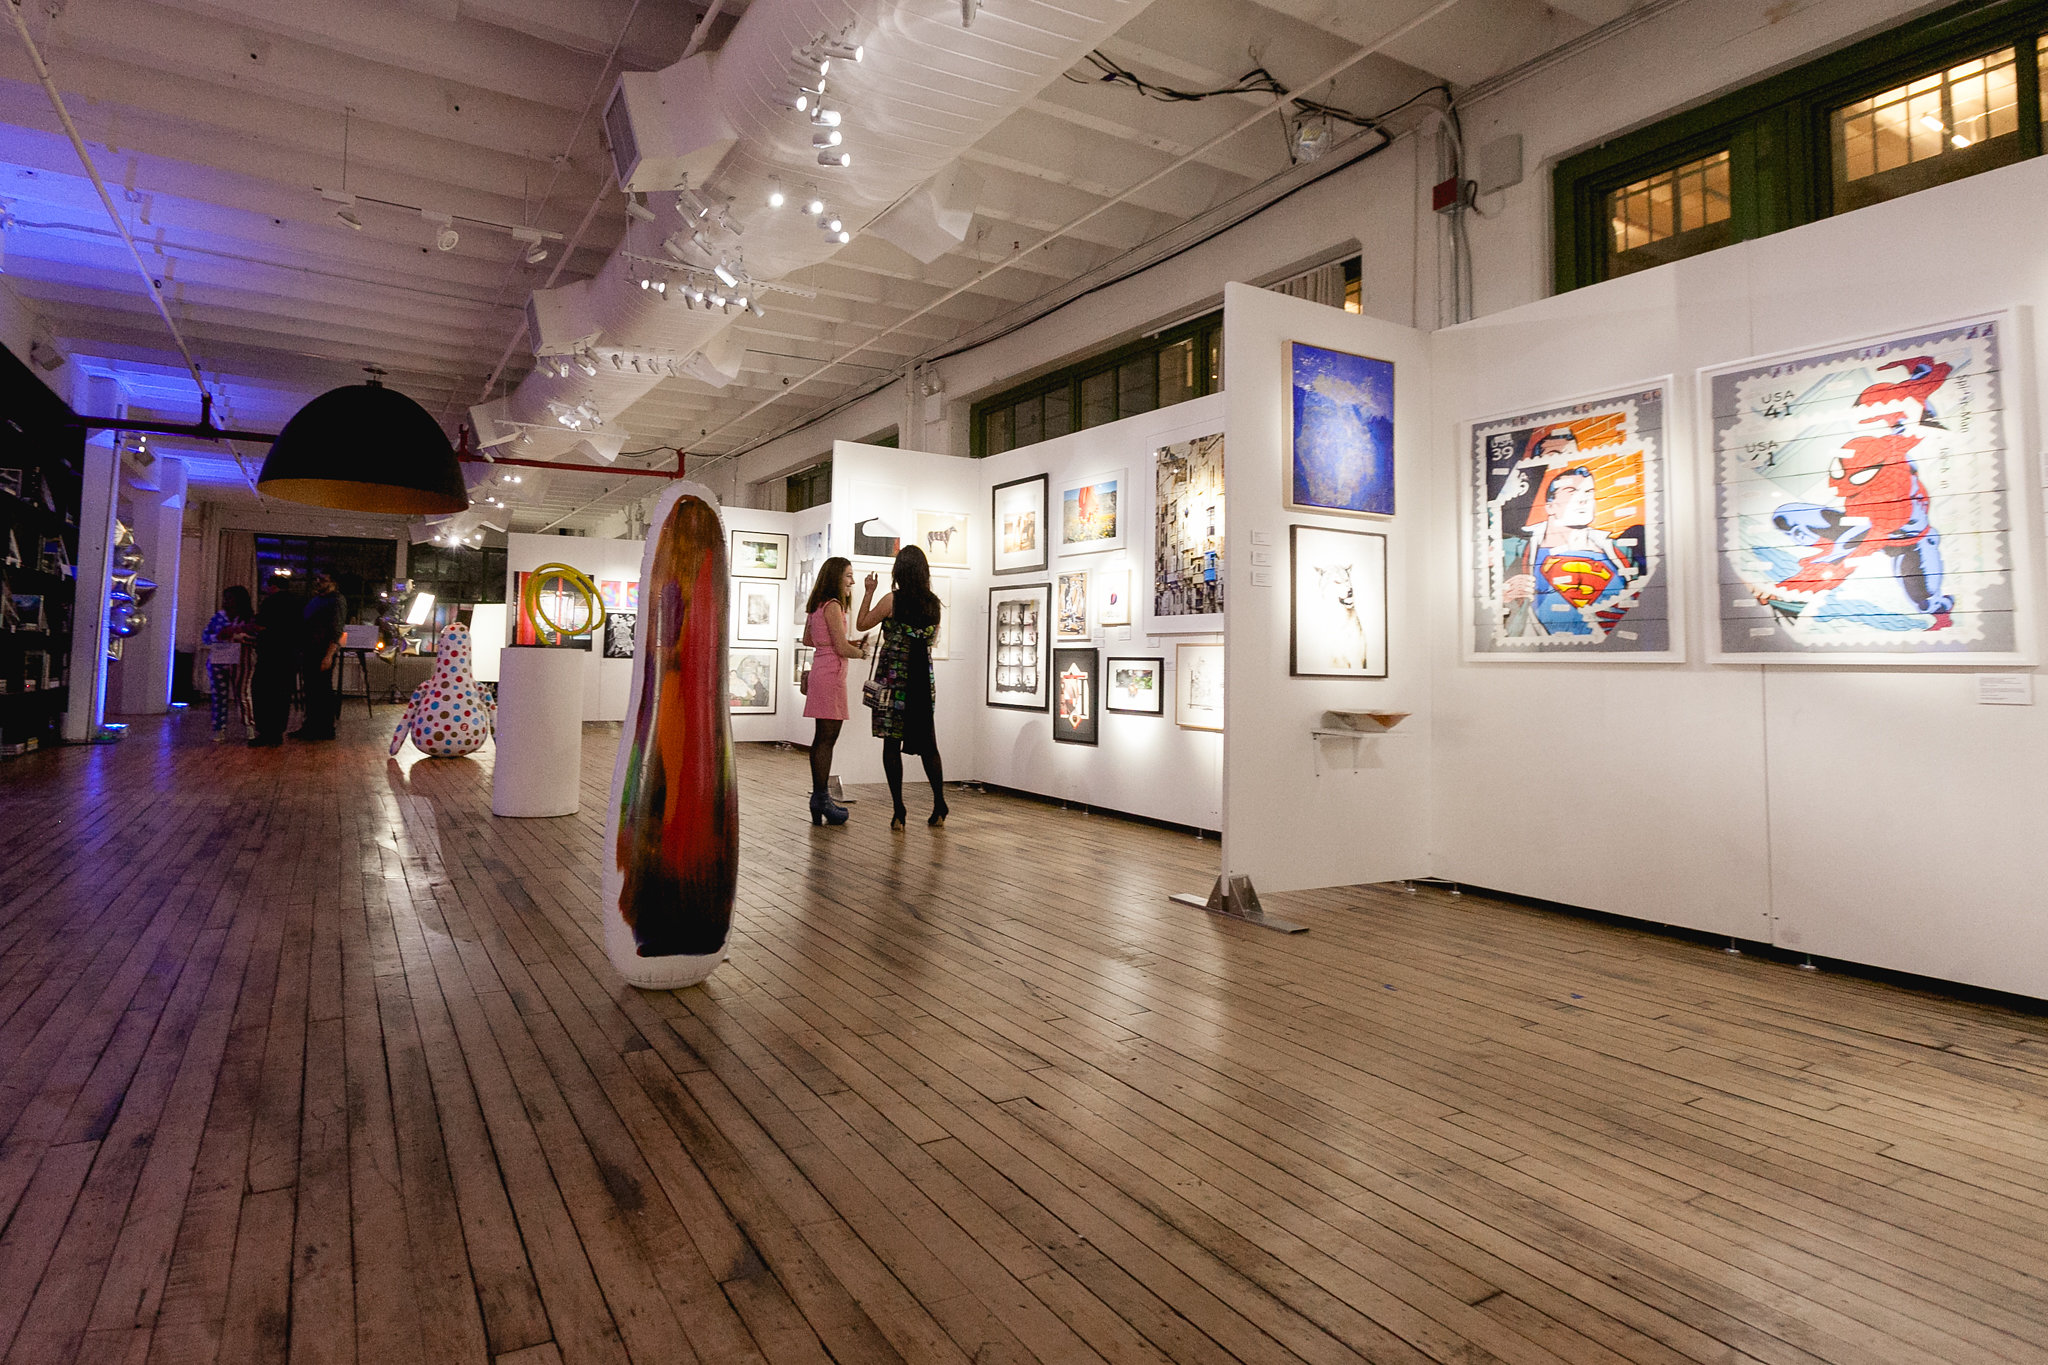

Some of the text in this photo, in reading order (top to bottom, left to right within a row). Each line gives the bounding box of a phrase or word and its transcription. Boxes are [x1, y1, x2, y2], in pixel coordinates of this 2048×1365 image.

[1761, 389, 1794, 404] USA
[1763, 402, 1792, 418] 41
[1491, 446, 1514, 461] 39
[1745, 440, 1778, 453] USA
